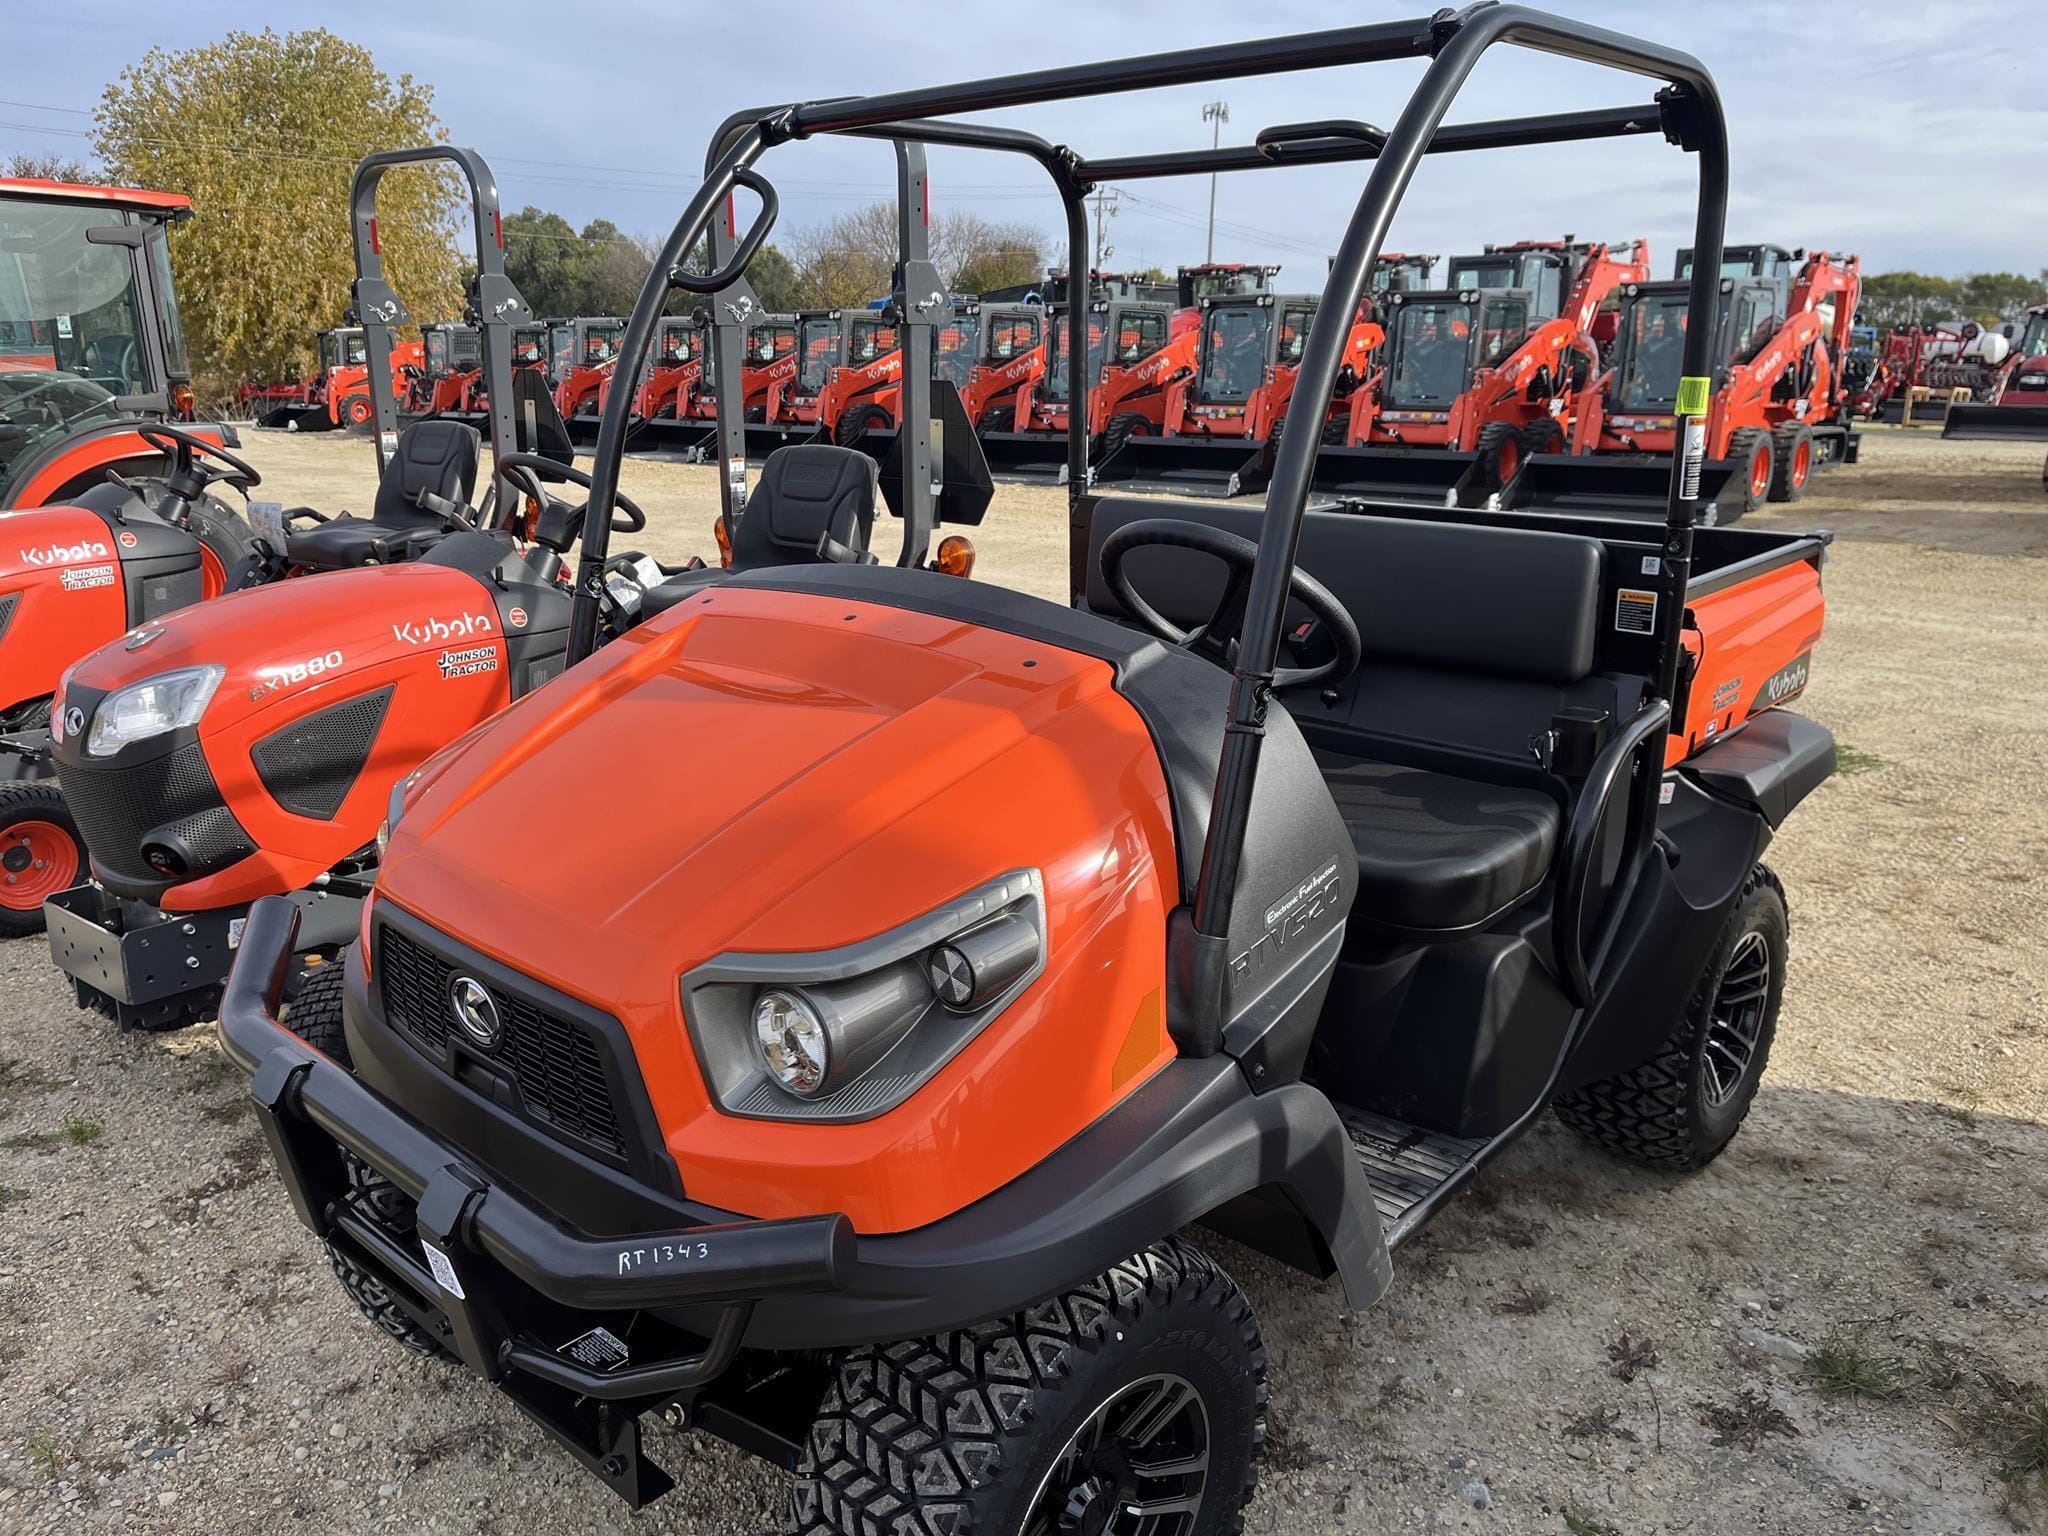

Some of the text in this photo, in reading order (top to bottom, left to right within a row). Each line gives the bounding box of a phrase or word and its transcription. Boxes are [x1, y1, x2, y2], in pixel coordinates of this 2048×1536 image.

[769, 359, 796, 379] Kubot
[867, 359, 900, 379] Kubota
[1006, 357, 1039, 380] Kubota
[1137, 357, 1170, 380] Kubota
[20, 539, 108, 566] Kubota
[61, 566, 112, 581] JOHNSON
[63, 577, 114, 591] TRACTOR
[392, 611, 491, 645] Kubota
[438, 647, 496, 666] JOHNSON
[249, 650, 343, 703] BX1880
[440, 660, 497, 678] TRACTOR
[1768, 664, 1806, 700] Kubota
[1267, 864, 1337, 924] Electronic Fuel Injection
[1230, 876, 1341, 989] RTV520
